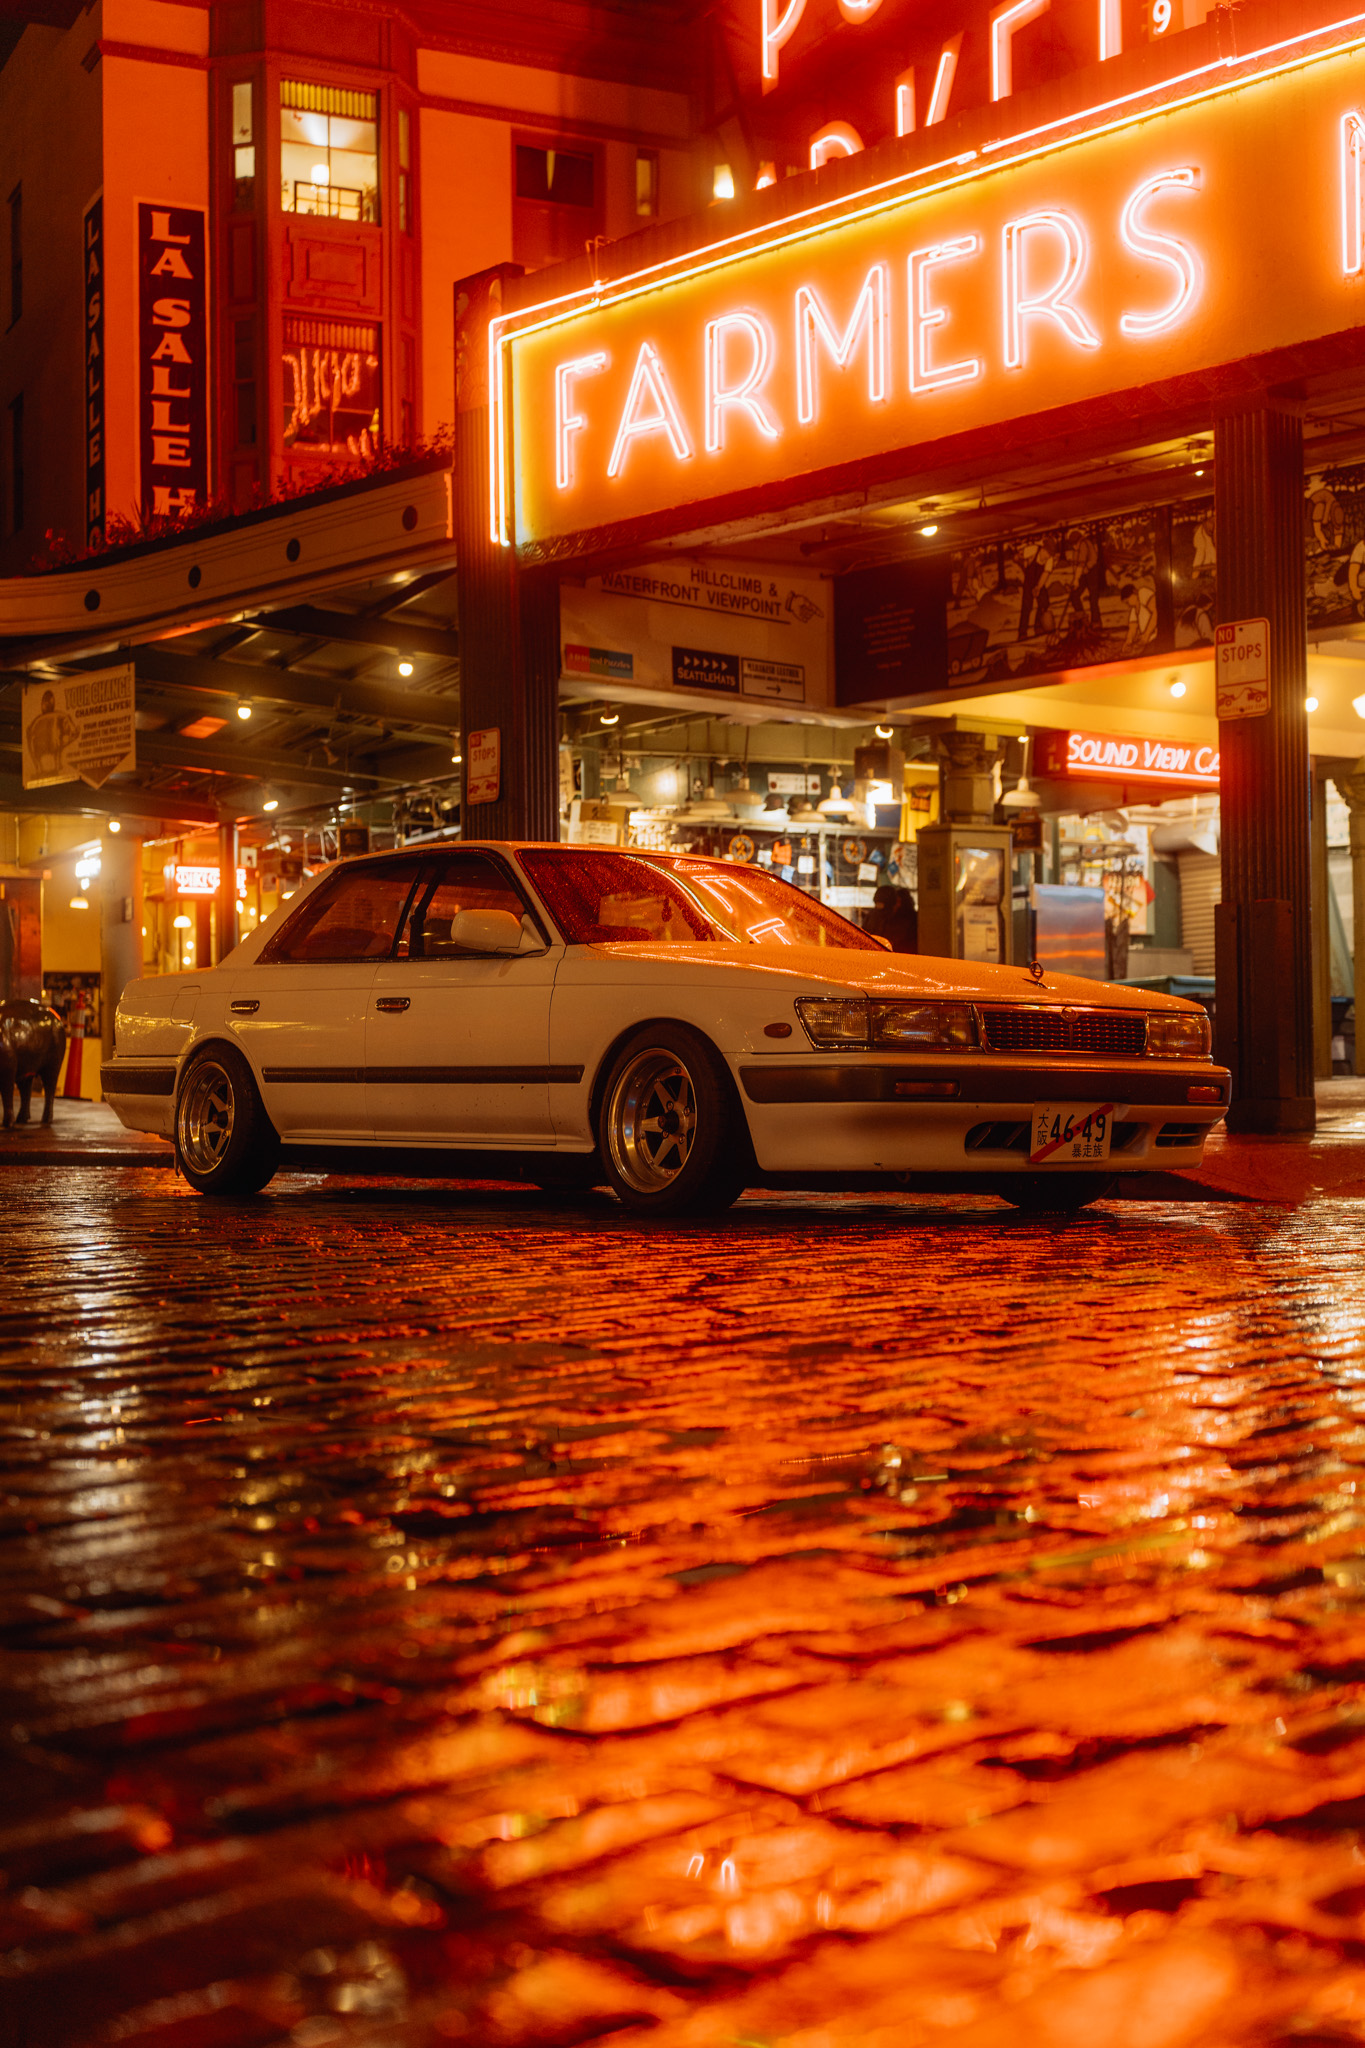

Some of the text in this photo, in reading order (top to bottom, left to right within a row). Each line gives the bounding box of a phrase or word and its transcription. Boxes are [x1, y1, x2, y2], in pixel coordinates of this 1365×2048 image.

[150, 210, 194, 280] LA
[554, 168, 1204, 490] FARMERS
[151, 297, 193, 467] SALLE
[601, 571, 782, 617] WATERFRONT VIEWPOINT
[690, 568, 778, 597] HILLCLIMB &
[1219, 628, 1233, 642] NO
[1222, 643, 1262, 663] STOPS
[64, 675, 132, 710] YOUR CHANGE
[75, 702, 108, 718] CHANGES
[473, 747, 496, 762] STOPS
[1067, 734, 1138, 767] SOUND
[1144, 741, 1190, 771] VIEW
[1037, 1113, 1049, 1146] 大阪
[1072, 1143, 1103, 1158] 暴走族
